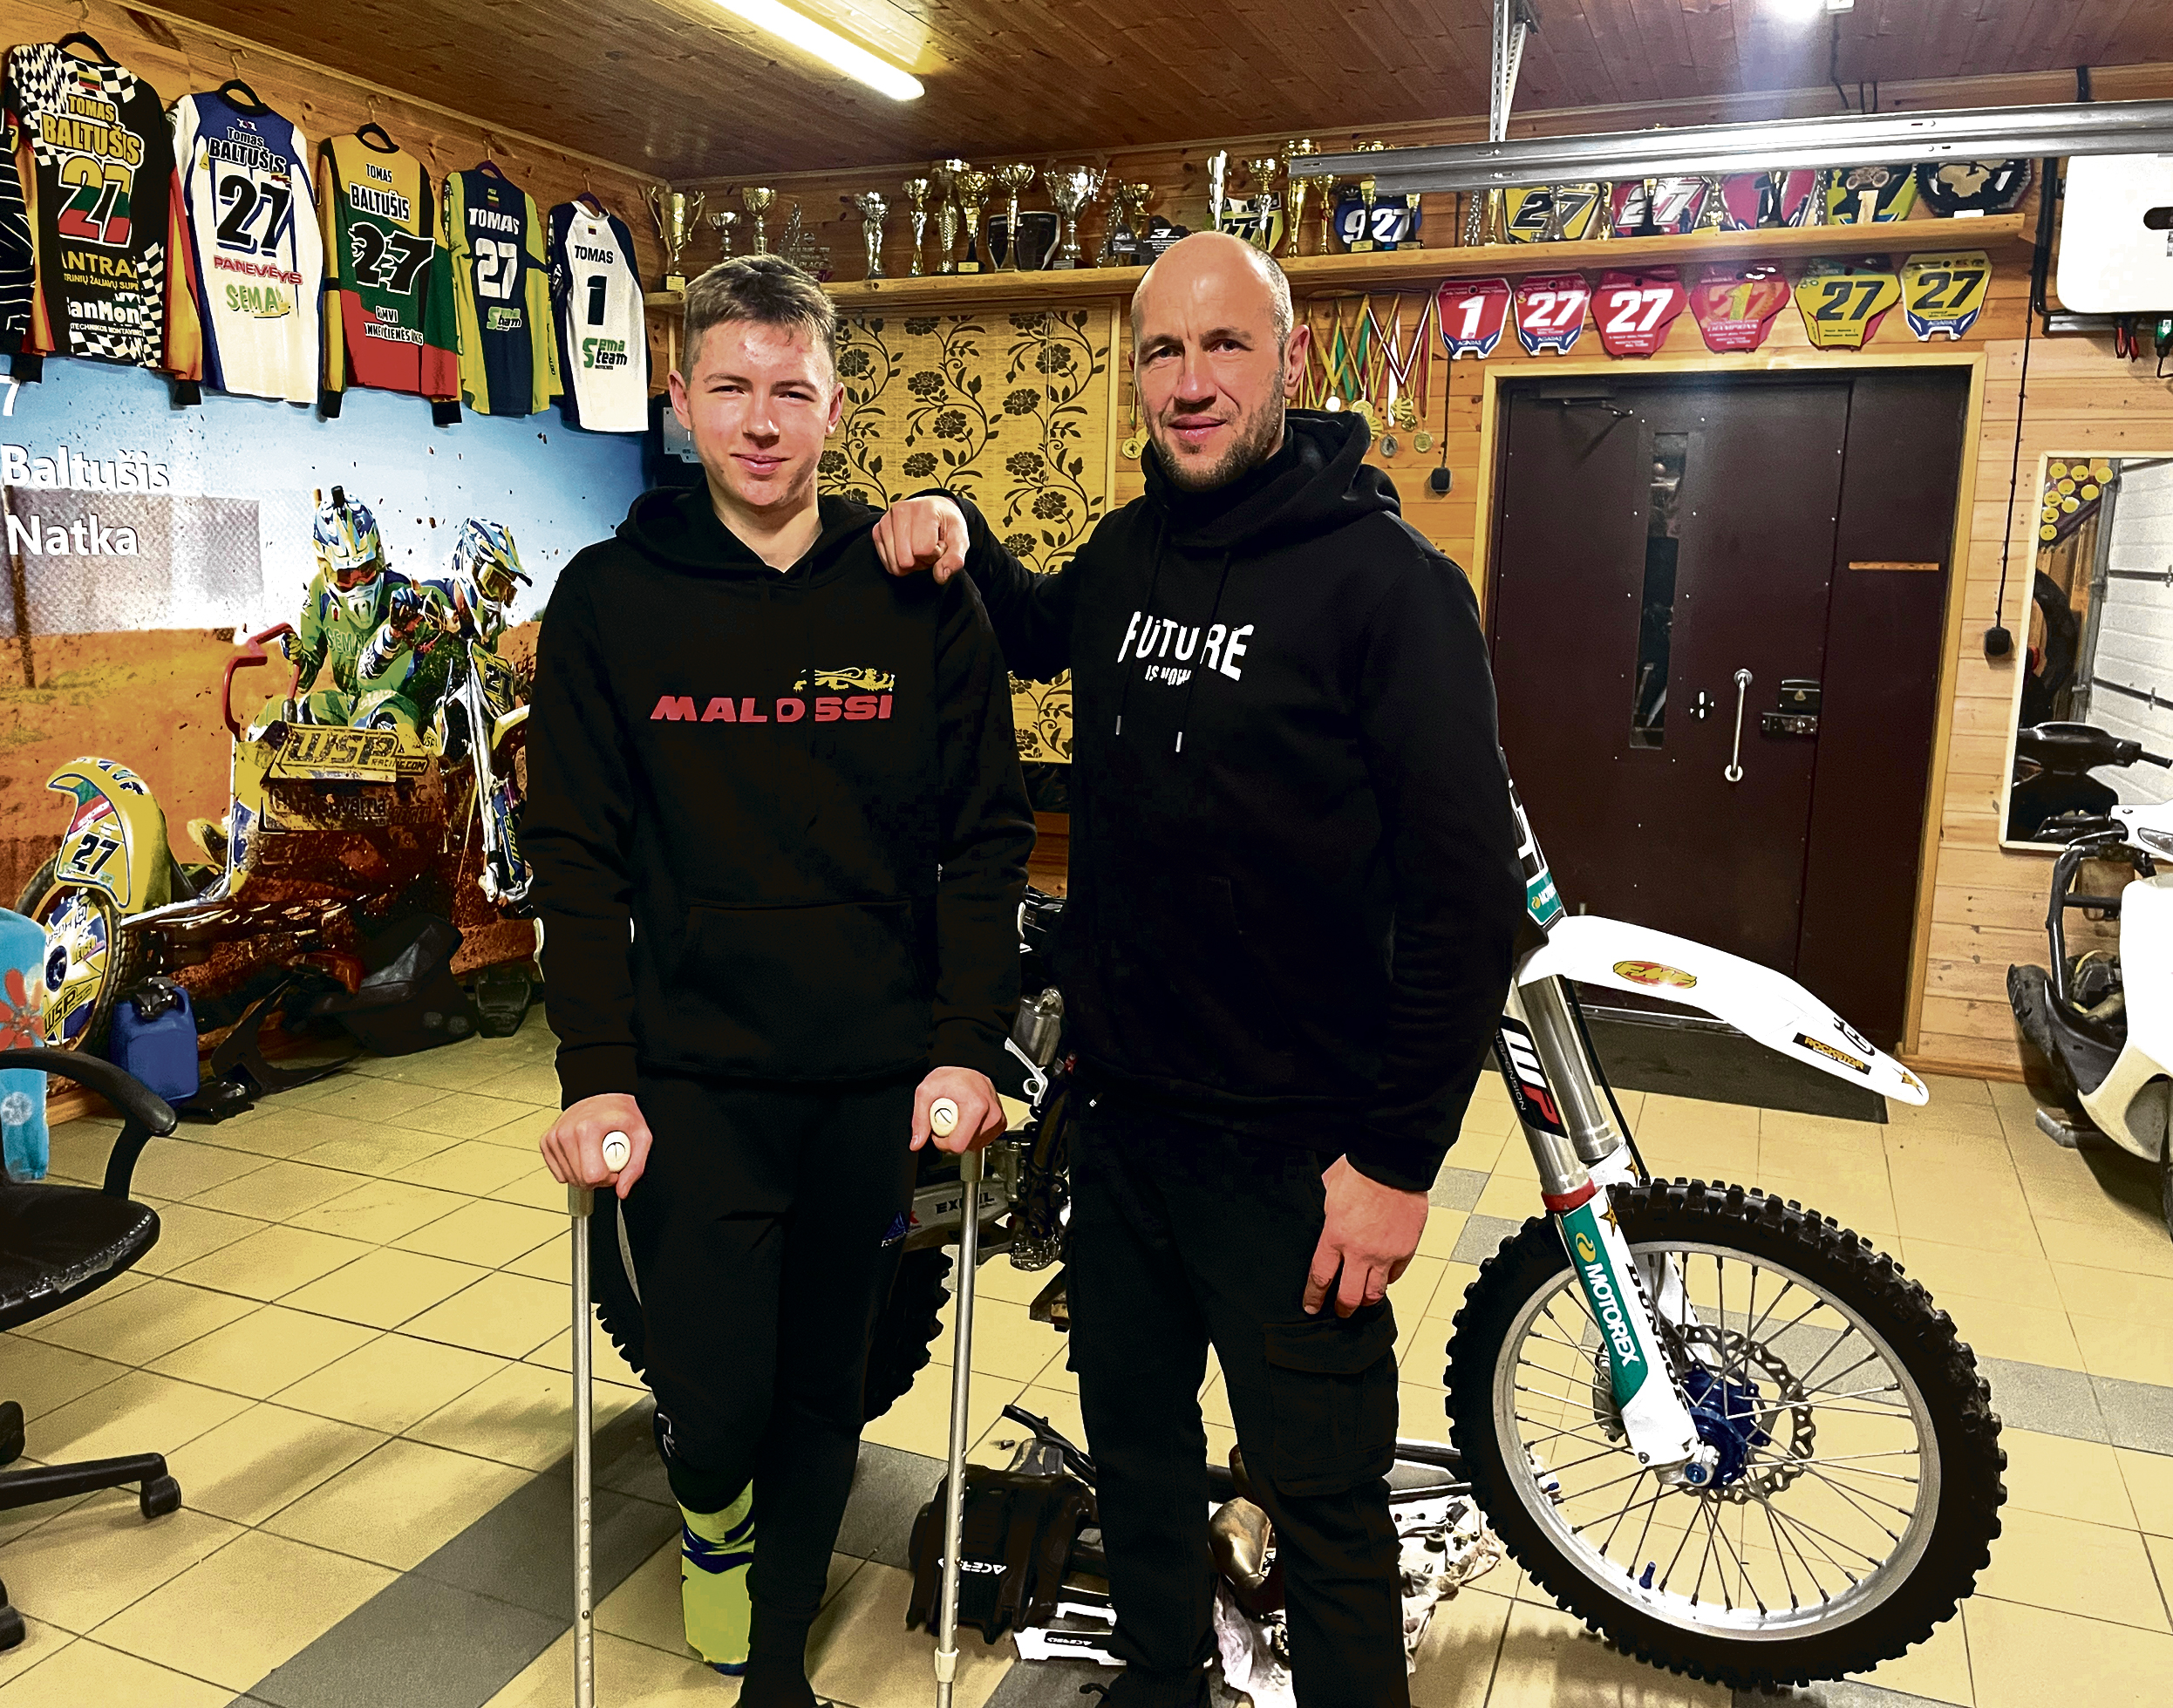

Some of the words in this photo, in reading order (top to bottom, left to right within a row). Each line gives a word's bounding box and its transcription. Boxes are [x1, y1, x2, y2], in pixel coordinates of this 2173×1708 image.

[68, 93, 116, 124] TOMAS
[41, 113, 145, 167] BALTUŠIS
[208, 137, 287, 174] BALTUŠIS
[227, 127, 265, 147] Tomas
[365, 162, 392, 184] TOMAS
[58, 155, 134, 248] 27
[217, 174, 291, 253] 27
[350, 183, 412, 222] BALTUŠIS
[468, 208, 521, 235] TOMAS
[1509, 190, 1596, 230] 27
[347, 221, 437, 295] 27
[475, 237, 518, 300] 27
[575, 244, 615, 265] TOMAS
[586, 275, 608, 326] 1
[1522, 289, 1586, 329] 27
[1816, 281, 1885, 321] 27
[1912, 269, 1986, 310] 27
[1458, 295, 1486, 340] 1
[1606, 288, 1674, 333] 27
[596, 350, 628, 366] team
[2, 445, 170, 488] Baltušis
[7, 514, 140, 556] Natka
[1117, 611, 1255, 682] FUTURE
[1145, 665, 1160, 682] IS
[71, 834, 120, 875] 27
[1584, 1262, 1640, 1367] MOTOREX
